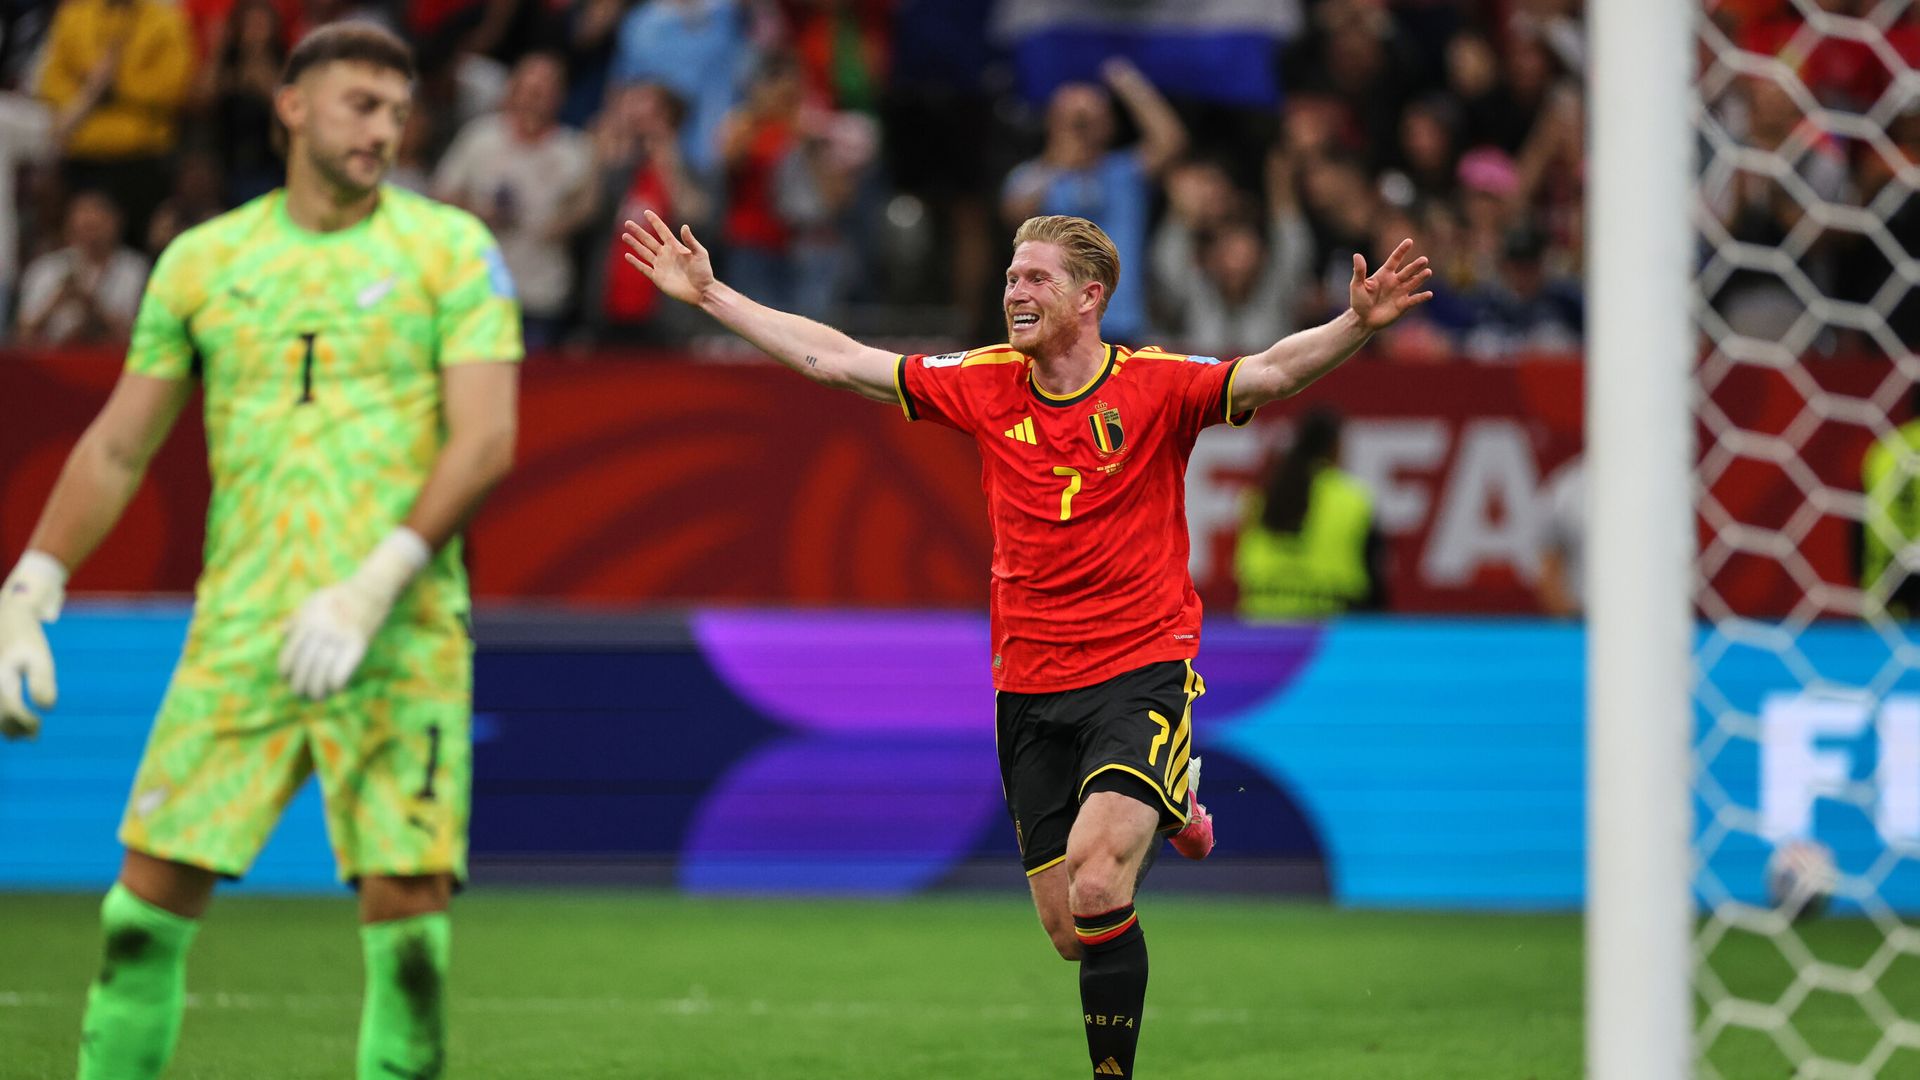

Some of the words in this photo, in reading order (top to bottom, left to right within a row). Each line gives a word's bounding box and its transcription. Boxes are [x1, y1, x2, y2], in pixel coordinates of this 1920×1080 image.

[297, 332, 317, 404] 1
[1053, 466, 1081, 520] 7
[1183, 418, 1546, 586] FFA
[417, 725, 441, 801] 1
[1148, 710, 1170, 766] 7
[1085, 1013, 1134, 1029] RBFA
